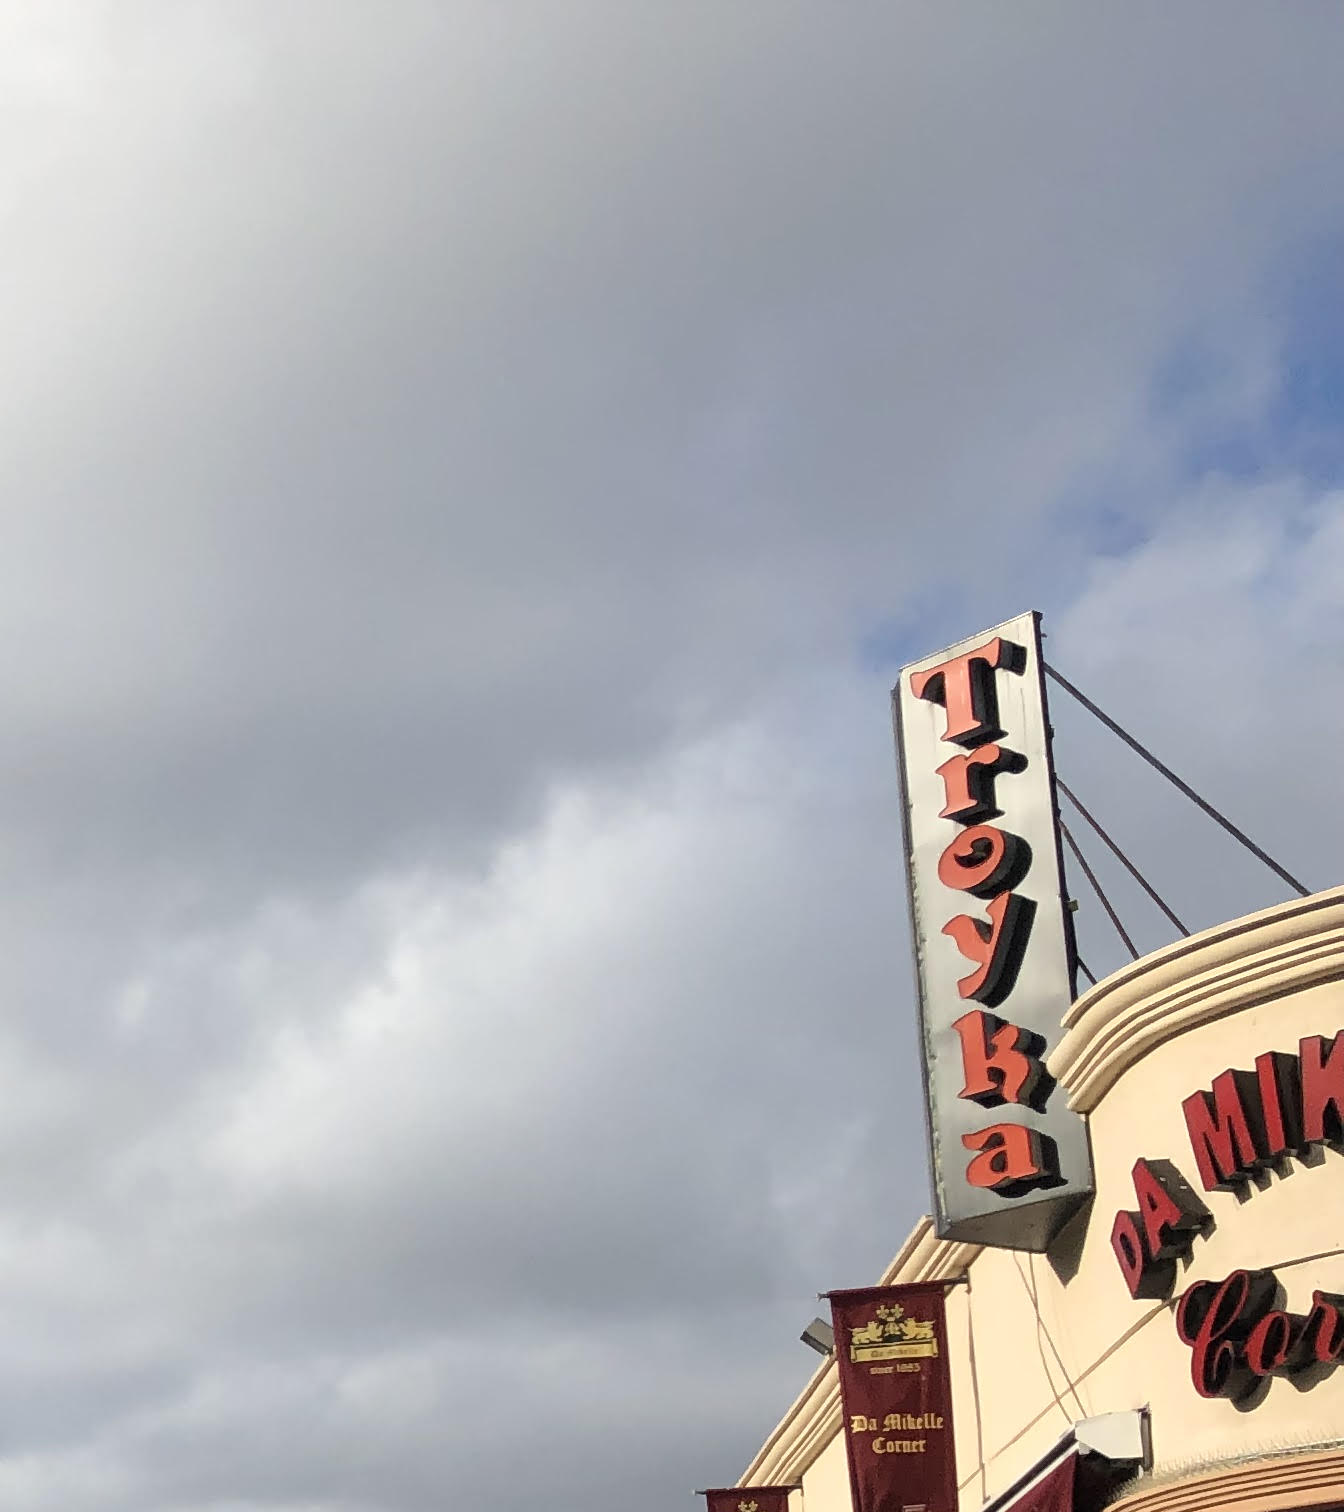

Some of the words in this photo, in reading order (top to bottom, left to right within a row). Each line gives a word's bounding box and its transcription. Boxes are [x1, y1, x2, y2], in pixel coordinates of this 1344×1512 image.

[909, 636, 1057, 1195] Troyka
[1110, 1157, 1184, 1300] DA
[850, 1414, 878, 1433] Da
[882, 1412, 944, 1432] Mikelle
[871, 1436, 926, 1454] Corner
